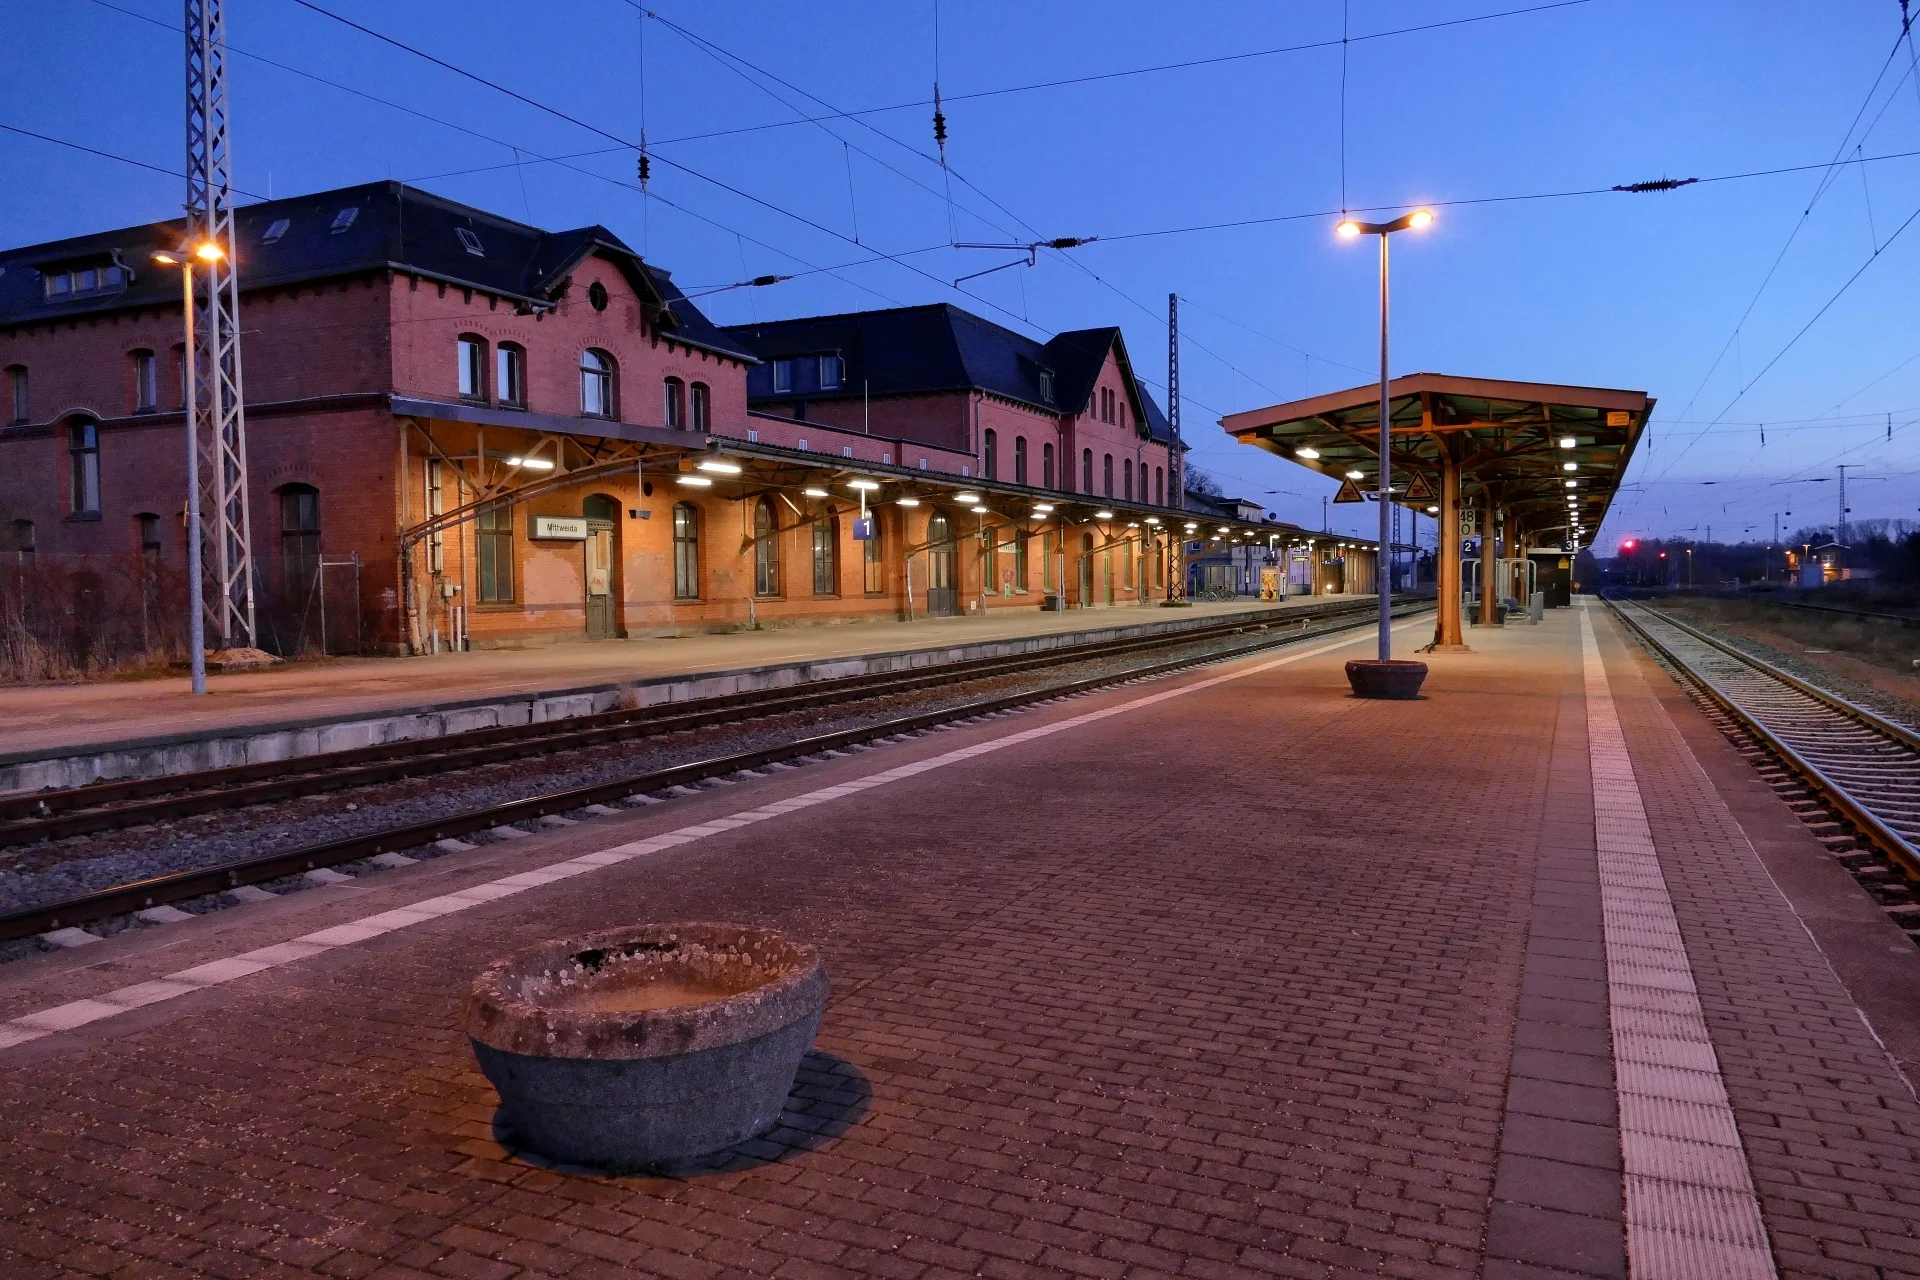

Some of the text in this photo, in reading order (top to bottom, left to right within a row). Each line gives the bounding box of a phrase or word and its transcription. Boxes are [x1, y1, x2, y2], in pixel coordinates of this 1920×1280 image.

[1460, 510, 1474, 522] 48
[546, 523, 578, 533] Mittweida
[863, 520, 870, 535] 1
[1464, 542, 1472, 552] 2
[1565, 540, 1573, 550] 3
[1270, 550, 1275, 558] 1
